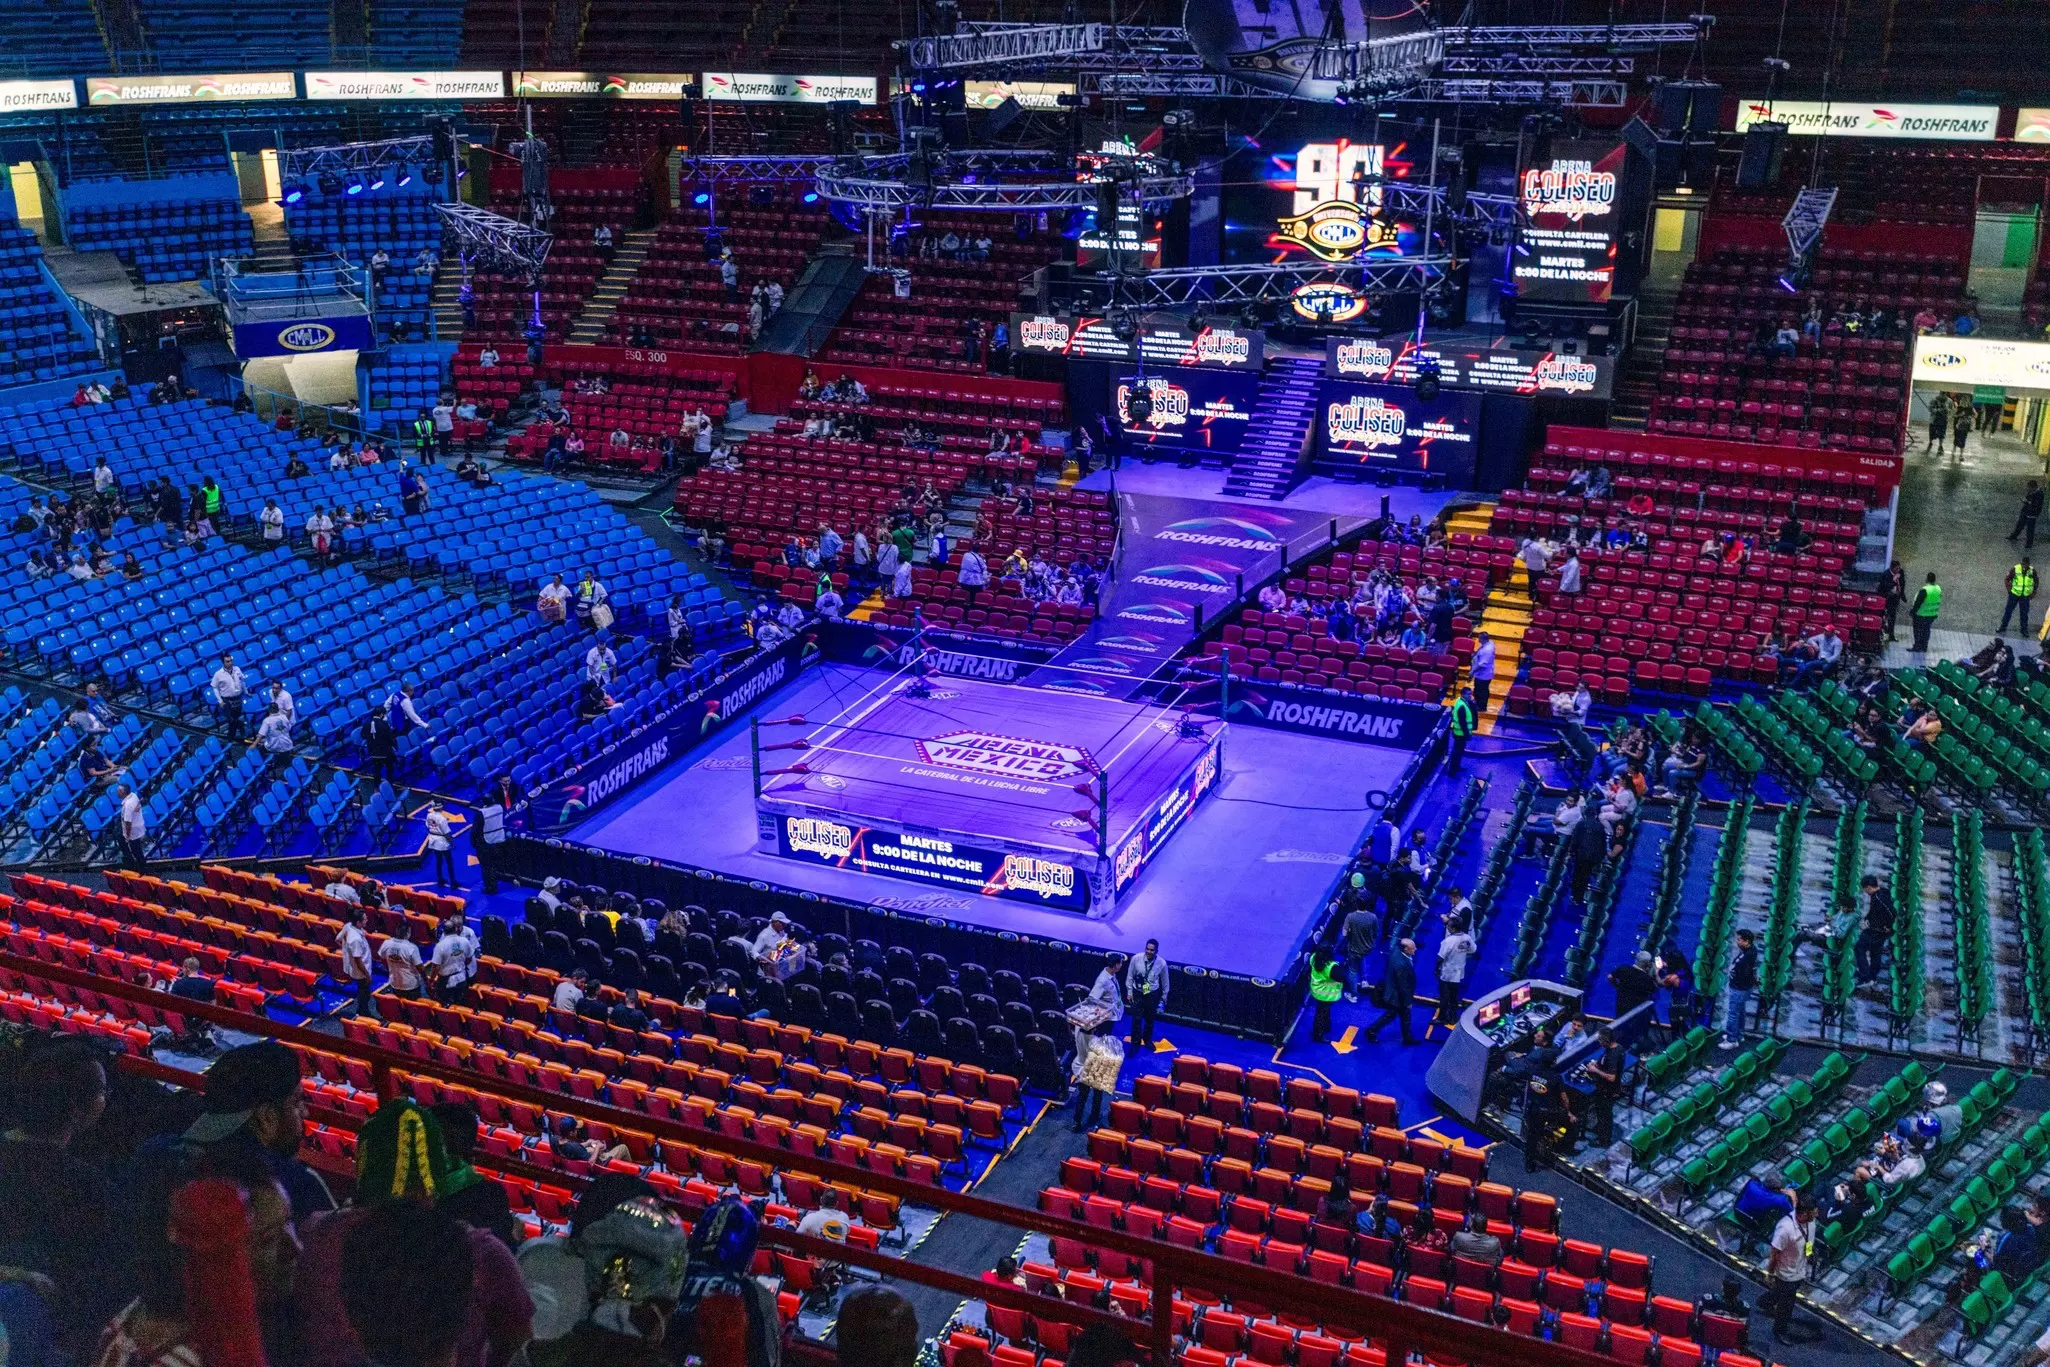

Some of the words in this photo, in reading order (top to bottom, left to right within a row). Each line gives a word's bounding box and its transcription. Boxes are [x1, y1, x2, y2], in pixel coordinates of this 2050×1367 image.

[121, 84, 192, 99] ROSHFRANS
[223, 81, 291, 96] ROSHFRANS
[339, 83, 403, 95] ROSHFRANS
[435, 82, 499, 94] ROSHFRANS
[540, 80, 600, 93] ROSHFRANS
[730, 83, 787, 96] ROSHFRANS
[815, 86, 873, 99] ROSHFRANS
[4, 92, 71, 106] ROSHFRANS
[1777, 113, 1860, 128] ROSHFRANS
[1900, 117, 1989, 133] ROSHFRANS
[1551, 159, 1592, 173] ARENA
[1525, 169, 1616, 203] COLISEO
[1565, 231, 1609, 241] CARTELERA
[1540, 256, 1586, 268] MARTES
[1540, 268, 1555, 279] DE
[1555, 269, 1569, 280] LA
[1570, 270, 1609, 282] NOCHE
[1021, 320, 1069, 342] COLISEO
[1087, 325, 1112, 333] MARTES
[1155, 331, 1180, 339] MARTES
[287, 328, 326, 346] CMLL
[1199, 334, 1248, 356] COLISEO
[648, 352, 667, 362] 300
[1337, 345, 1391, 366] COLISEO
[1490, 356, 1518, 365] MARTES
[1538, 361, 1596, 383] COLISEO
[1351, 395, 1384, 408] ARENA
[1328, 403, 1404, 436] COLISEO
[1444, 432, 1471, 442] NOCHE
[1860, 457, 1888, 466] SALIDA
[1154, 531, 1281, 551] ROSHFRANS
[1131, 575, 1231, 594] ROSHFRANS
[1117, 612, 1188, 625] ROSHFRANS
[722, 657, 785, 720] ROSHFRANS
[1268, 700, 1403, 739] ROSHFRANS
[956, 738, 1065, 762] ARENA
[932, 746, 1066, 775] MEXICO
[587, 736, 669, 808] ROSHFRANS
[901, 766, 912, 774] LA
[914, 768, 959, 781] CATEDRAL
[960, 775, 974, 783] DE
[974, 777, 987, 785] LA
[988, 779, 1020, 791] LUCHA
[1020, 785, 1050, 795] LIBRE
[787, 817, 851, 848] COLISEO
[900, 834, 953, 853] MARTES
[872, 844, 900, 858] 9:00
[901, 849, 918, 862] DE
[919, 850, 936, 865] LA
[936, 856, 983, 873] NOCHE
[852, 858, 889, 871] CONSULTA
[890, 862, 930, 878] CARTELERA
[930, 871, 941, 880] EN
[943, 874, 1005, 891] www.cmll.com
[1004, 854, 1074, 889] COLISEO
